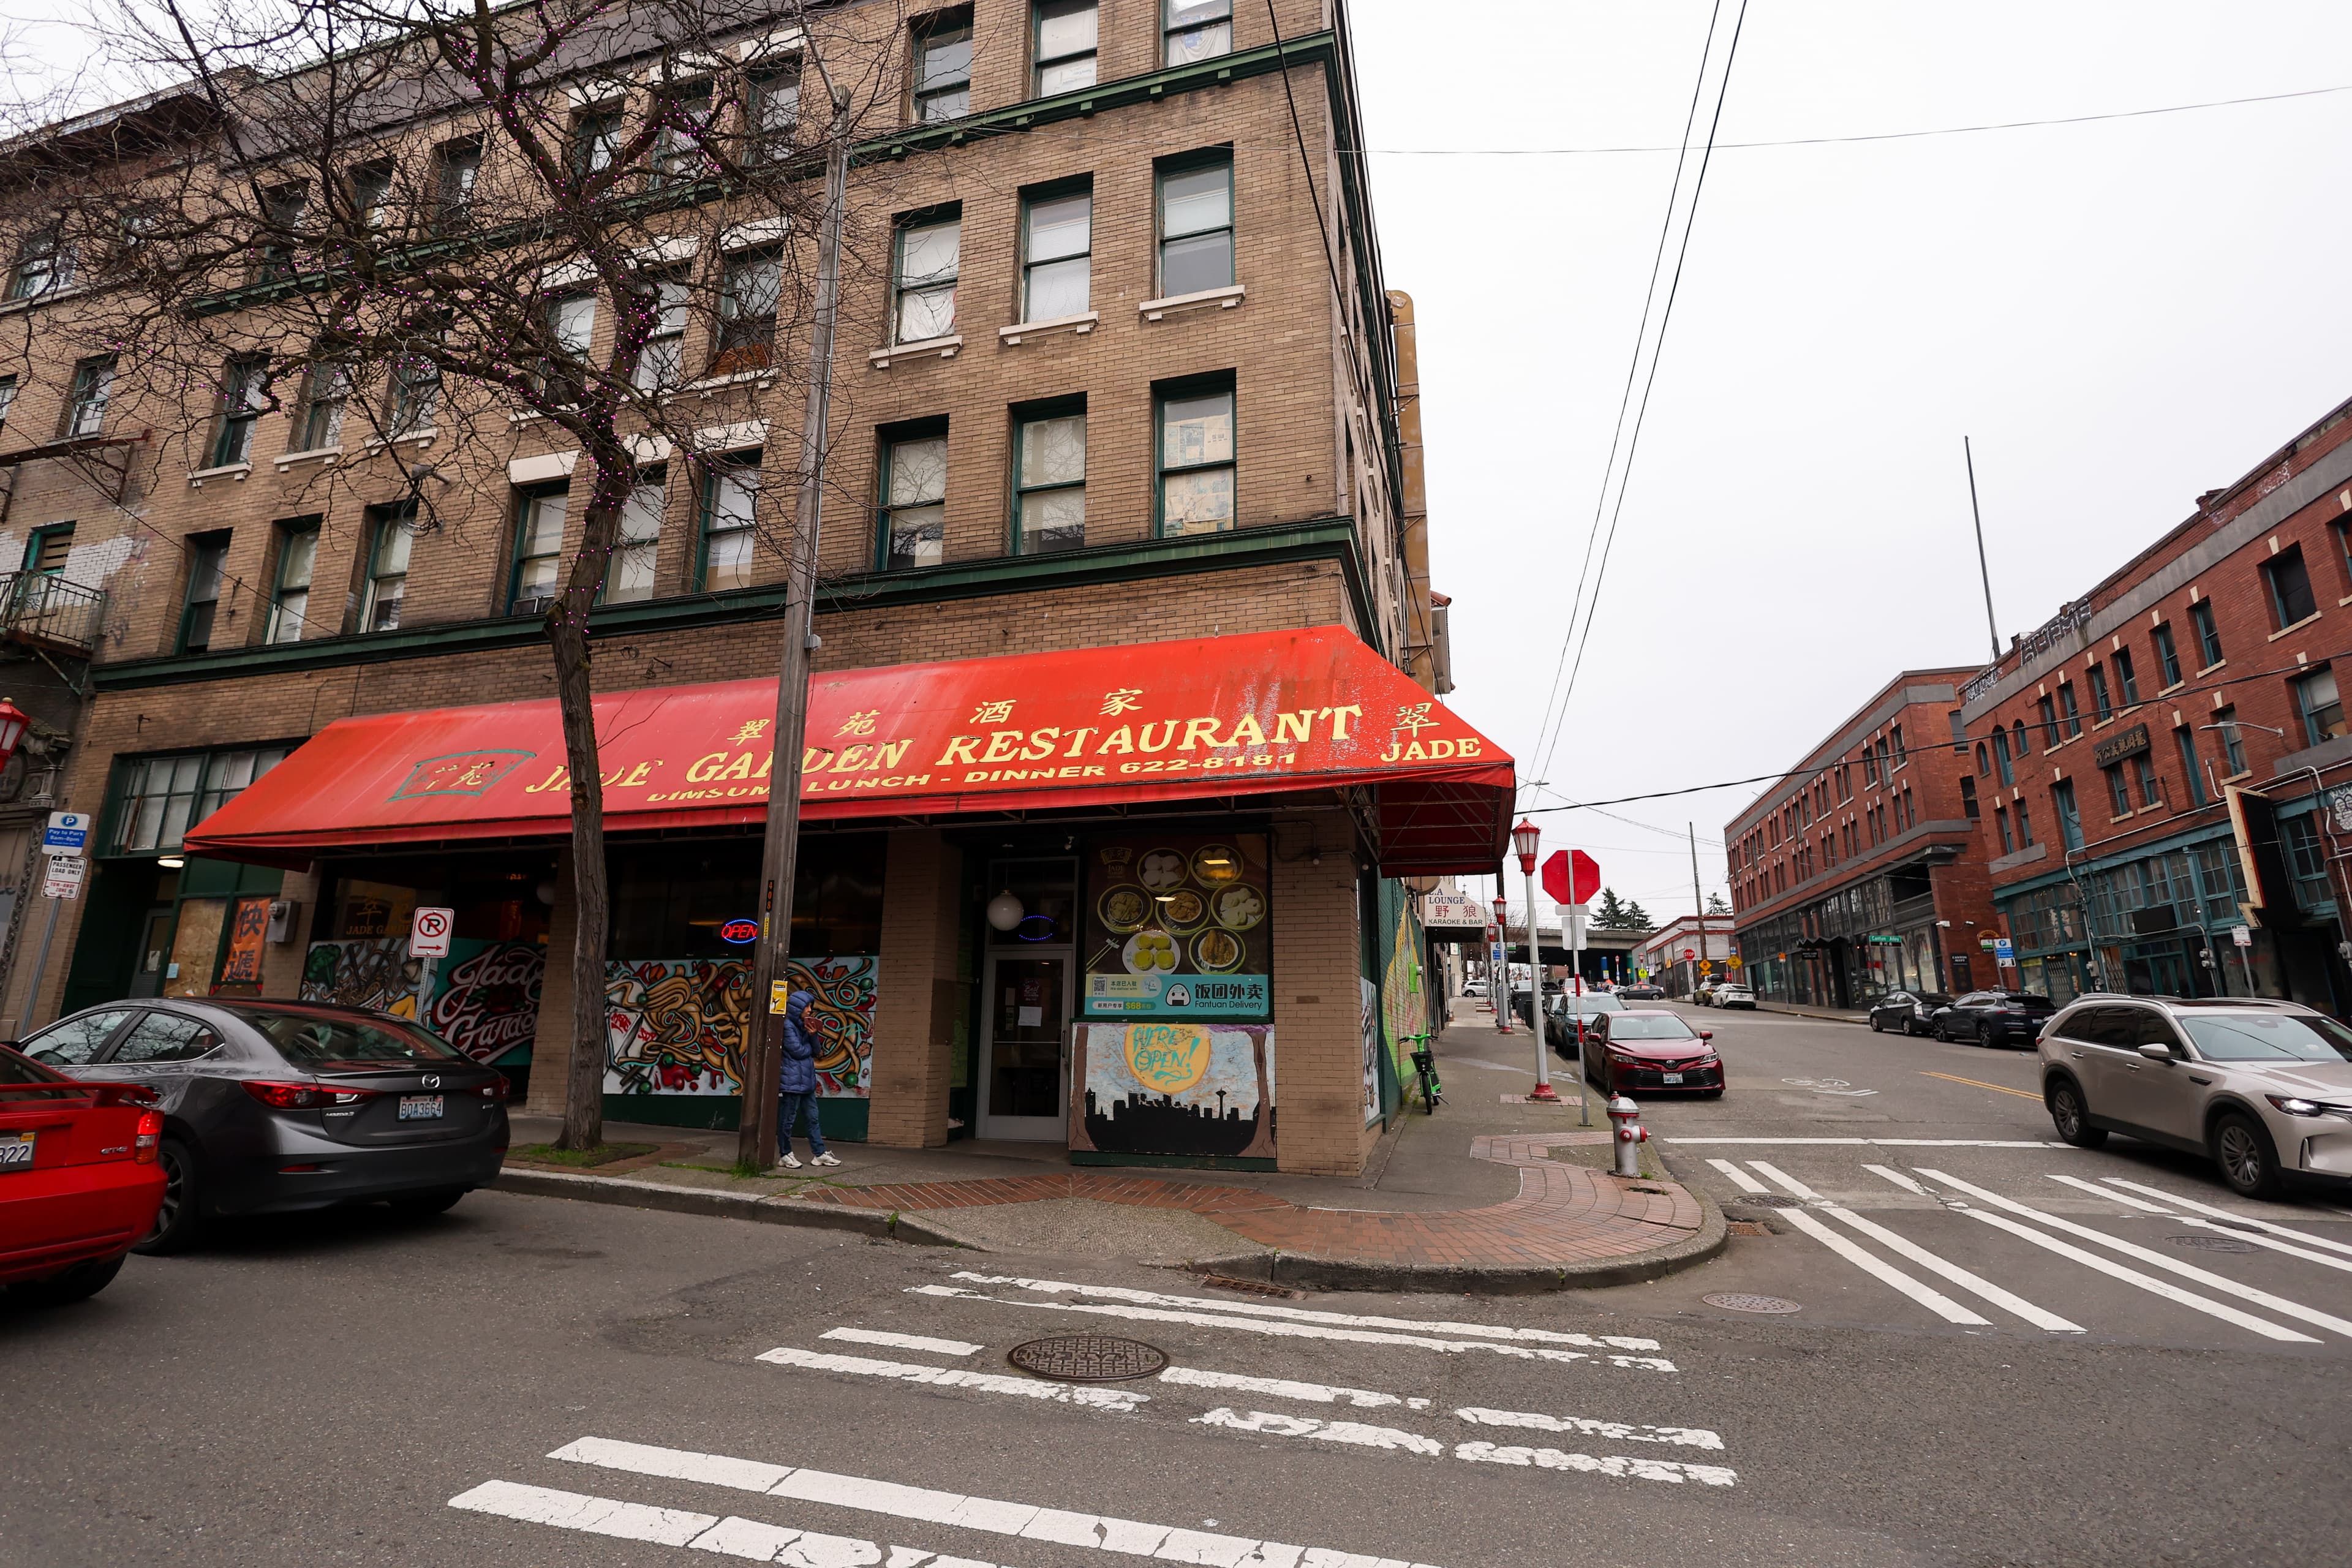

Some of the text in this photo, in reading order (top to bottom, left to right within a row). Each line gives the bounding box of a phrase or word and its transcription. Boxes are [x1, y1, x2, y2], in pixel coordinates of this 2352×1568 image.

[1390, 702, 1441, 737] 翠
[935, 704, 1363, 766] RESTAURANT
[1381, 737, 1482, 763] JADE
[806, 774, 930, 792] LUNCH
[964, 765, 1106, 783] DINNER
[1119, 752, 1297, 774] 622-8181
[1435, 905, 1477, 918] 野狼
[722, 925, 757, 938] OPEN
[1195, 983, 1263, 1000] 饭团外卖
[1229, 1000, 1262, 1011] Delivery
